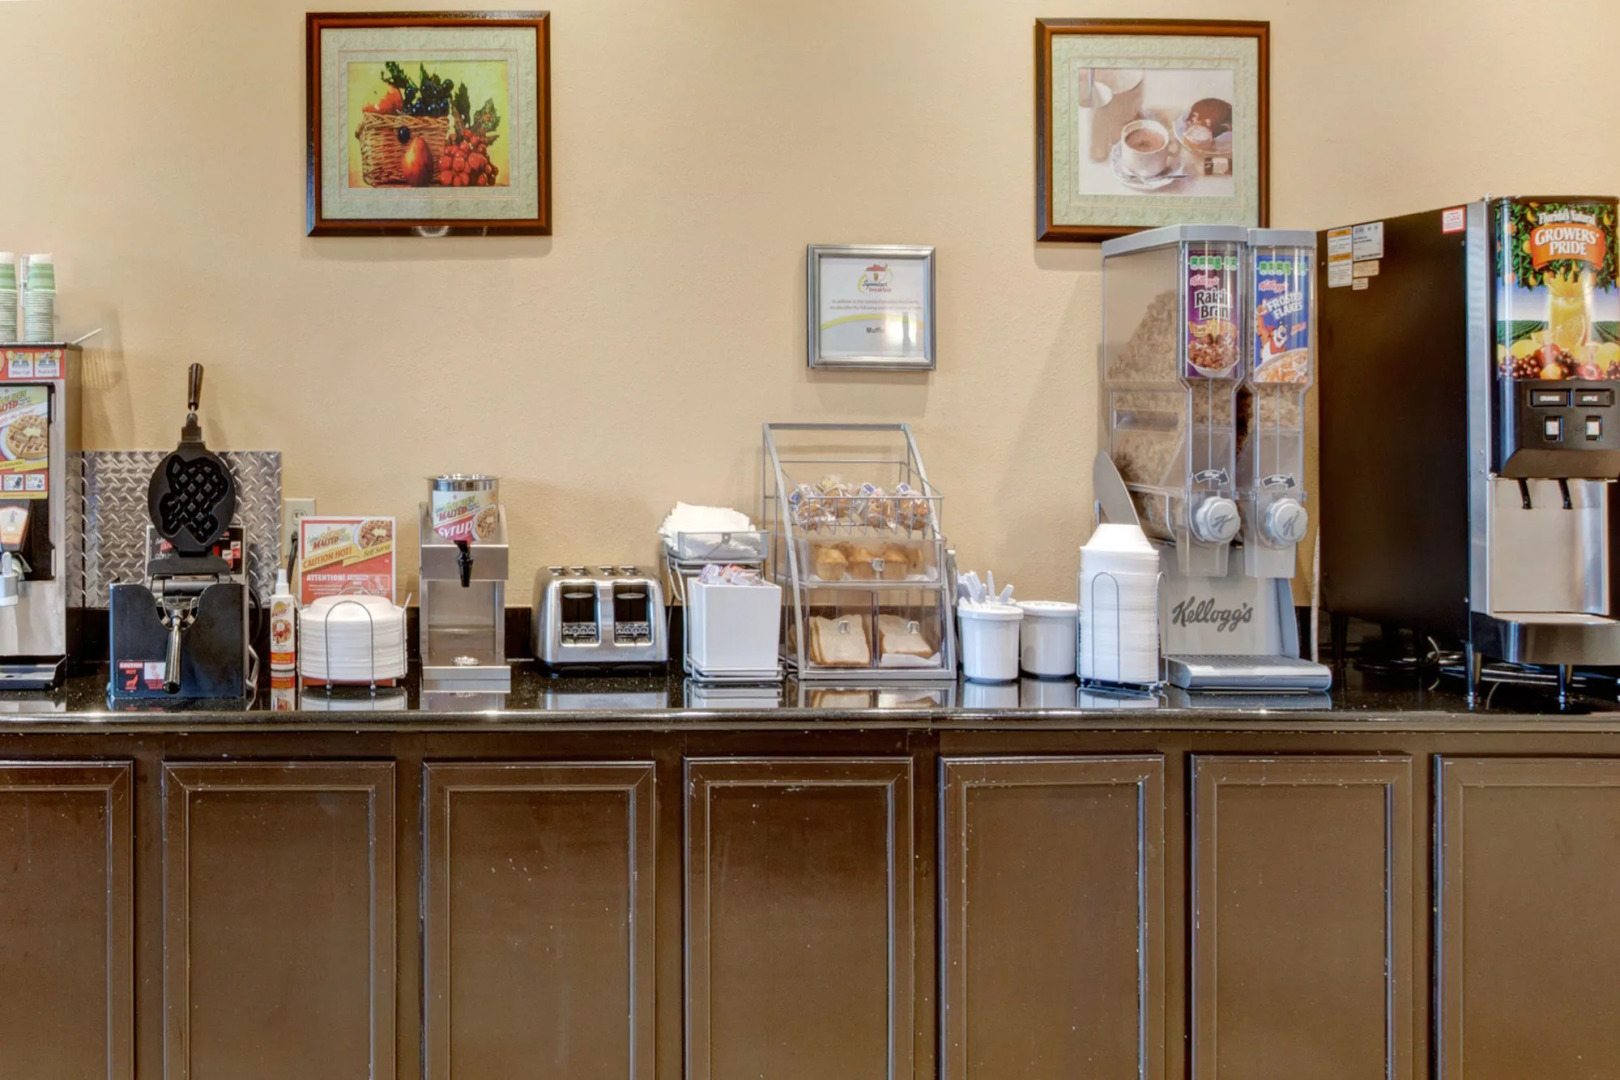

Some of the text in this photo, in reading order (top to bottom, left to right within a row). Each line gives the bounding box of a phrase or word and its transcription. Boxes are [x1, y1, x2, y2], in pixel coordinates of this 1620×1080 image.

[1549, 241, 1587, 256] PRIDE
[1273, 302, 1304, 320] FLAKES
[438, 506, 468, 521] MALTED
[312, 536, 340, 550] MALTED
[302, 546, 353, 569] CAUTION HOT!
[1172, 595, 1254, 633] Kellogg's
